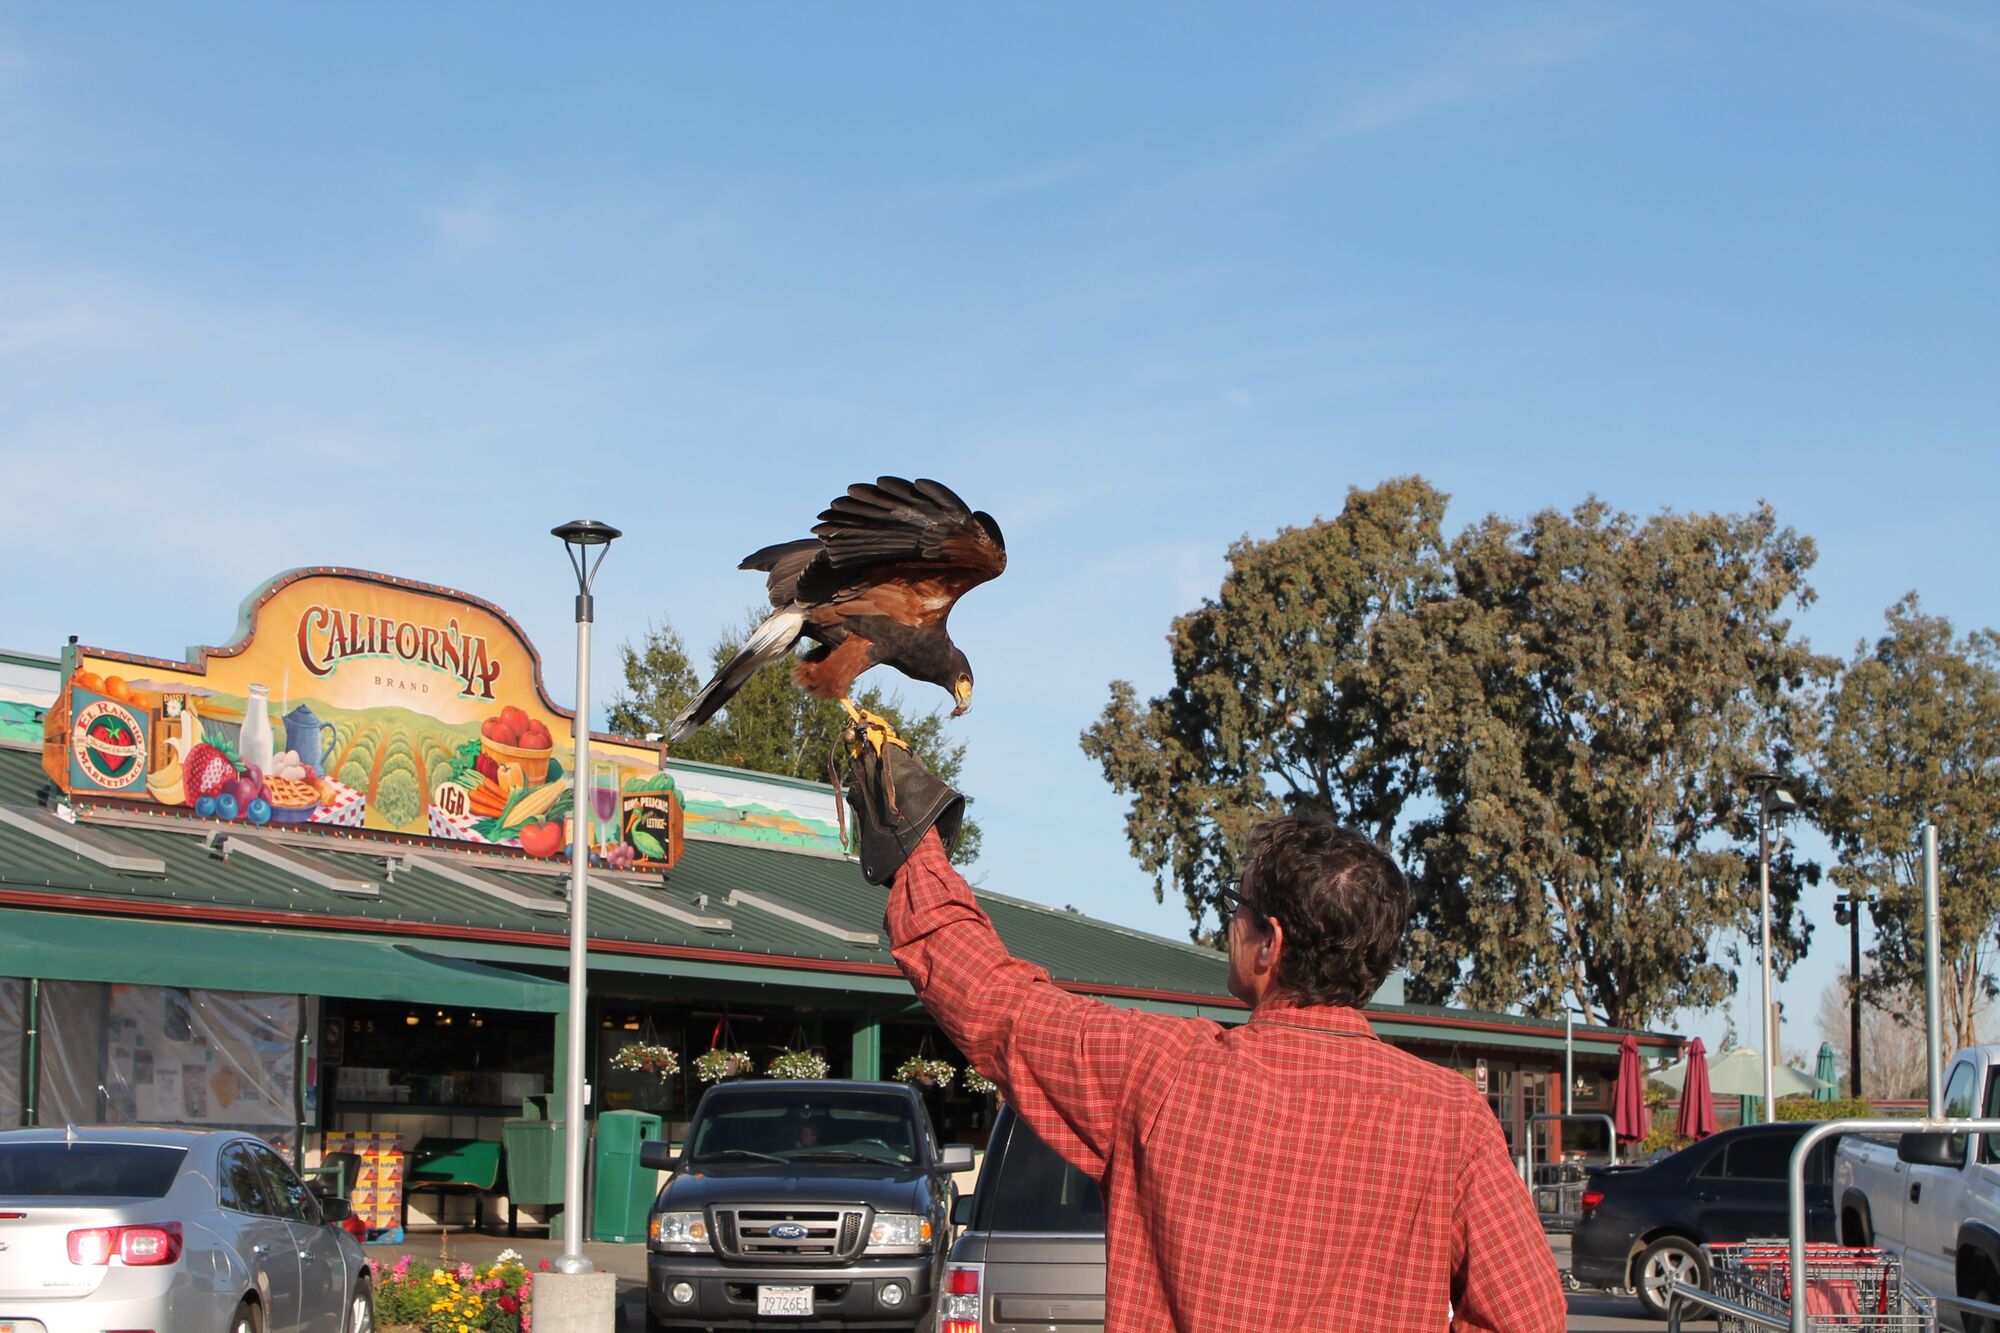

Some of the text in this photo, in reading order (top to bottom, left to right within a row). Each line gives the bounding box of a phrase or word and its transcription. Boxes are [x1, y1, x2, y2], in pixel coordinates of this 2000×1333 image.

[297, 605, 501, 699] CALIFORNIA
[374, 675, 429, 694] BRAND
[78, 702, 143, 745] EL RANCHO
[79, 751, 142, 787] MARKETPLACE
[440, 786, 464, 815] IGA
[776, 1226, 800, 1236] Ford
[762, 1296, 808, 1310] 79726E1
